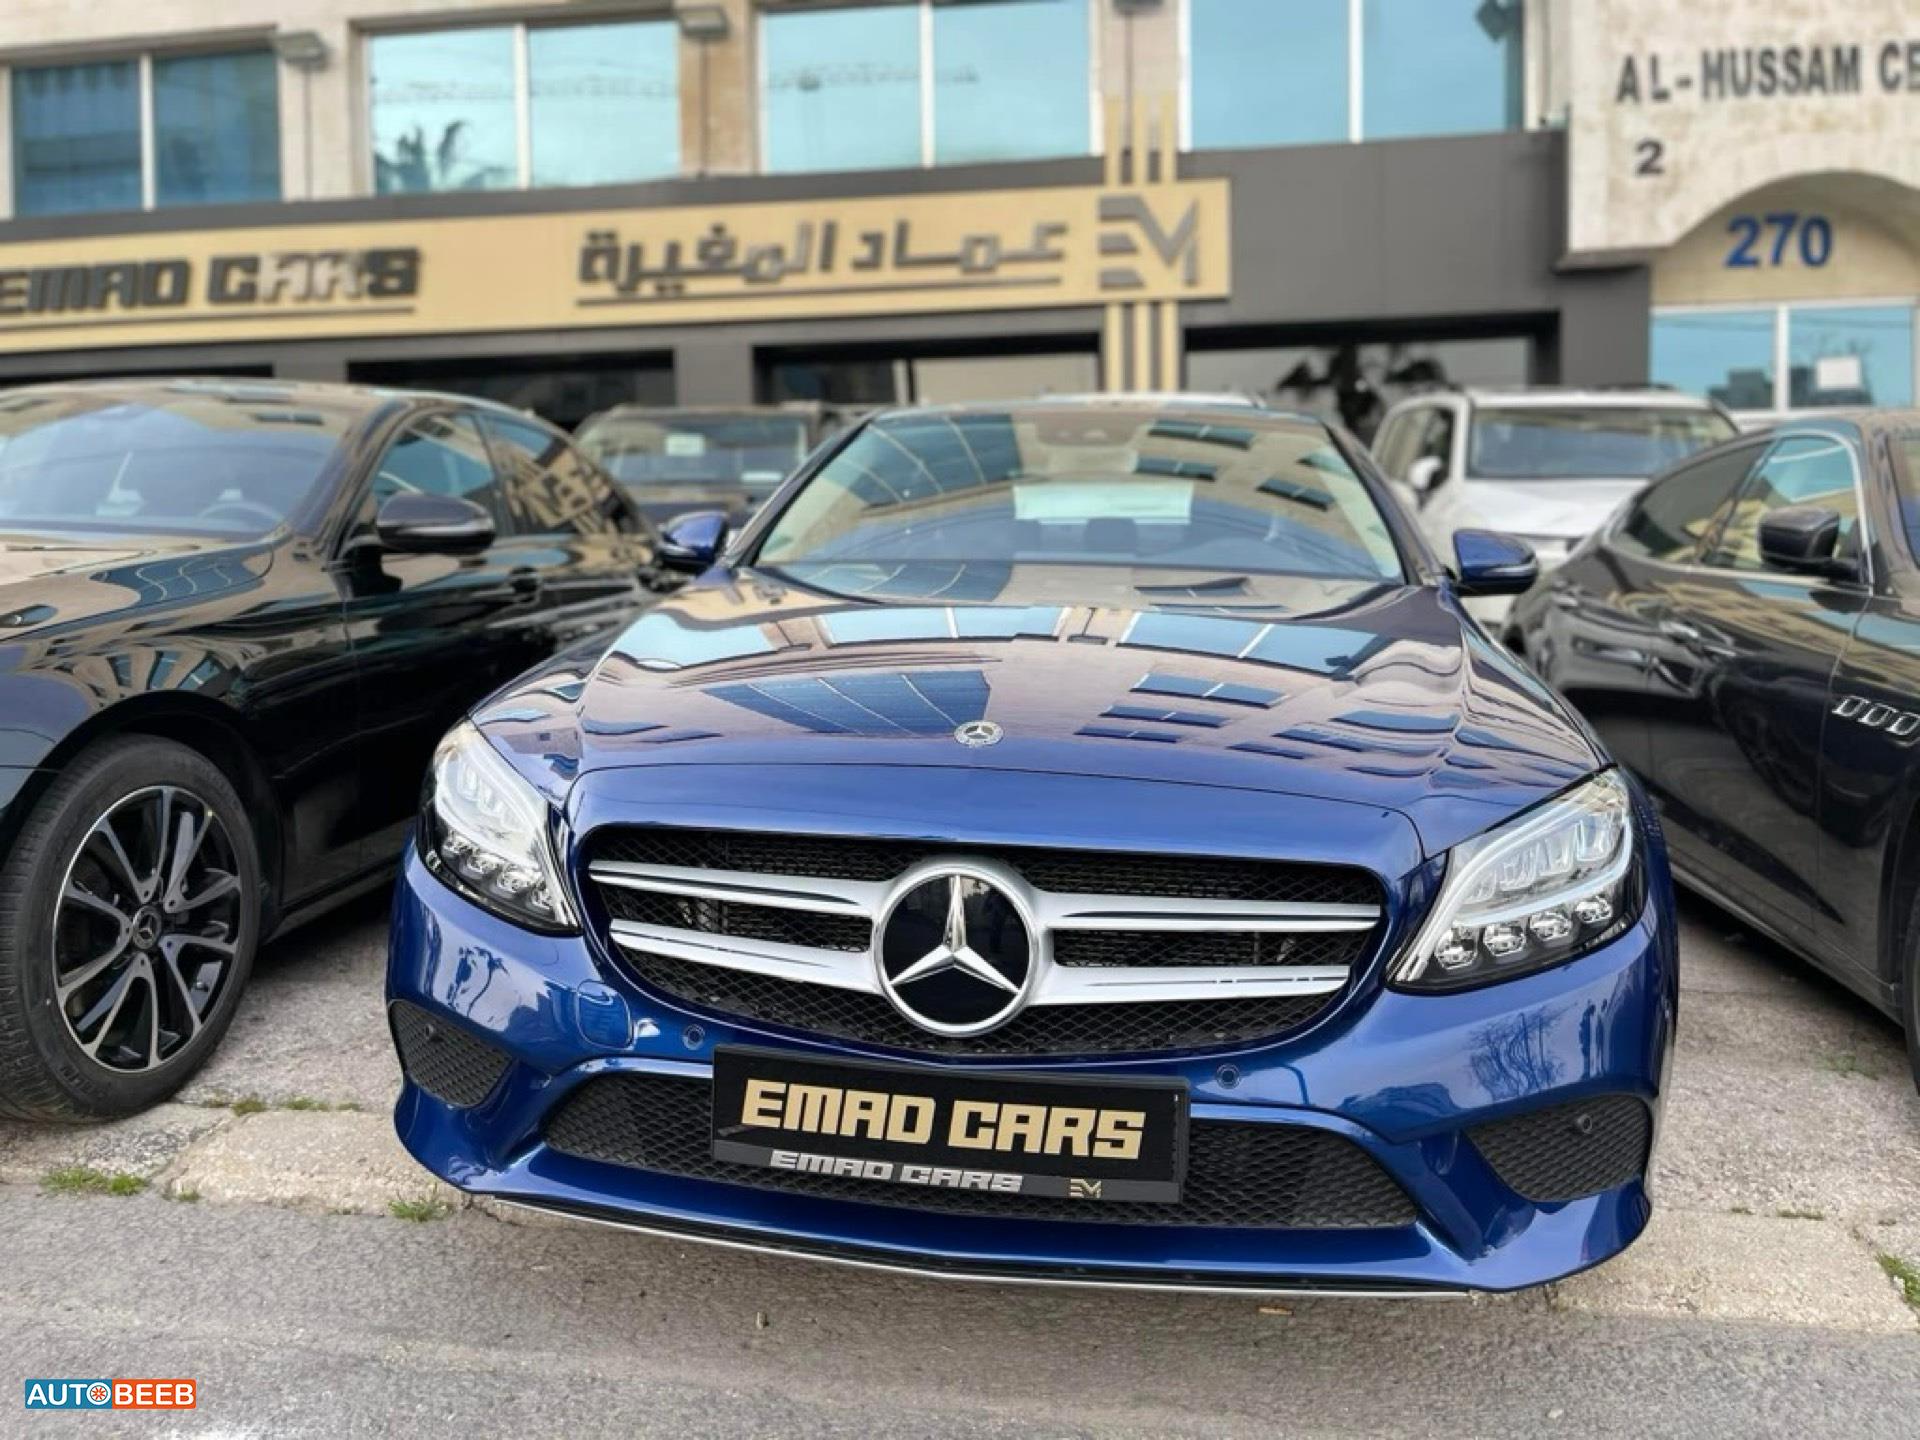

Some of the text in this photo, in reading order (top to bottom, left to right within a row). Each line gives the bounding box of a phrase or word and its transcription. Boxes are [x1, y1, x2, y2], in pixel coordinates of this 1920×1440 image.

[1616, 45, 1860, 103] AL-HUSSAM
[1634, 138, 1664, 176] 2
[577, 220, 838, 296] المغيرة
[1725, 213, 1832, 268] 270
[0, 259, 193, 314] EMAD
[741, 1079, 1146, 1160] EMAD CARS
[770, 1149, 1023, 1193] EMAD CARS
